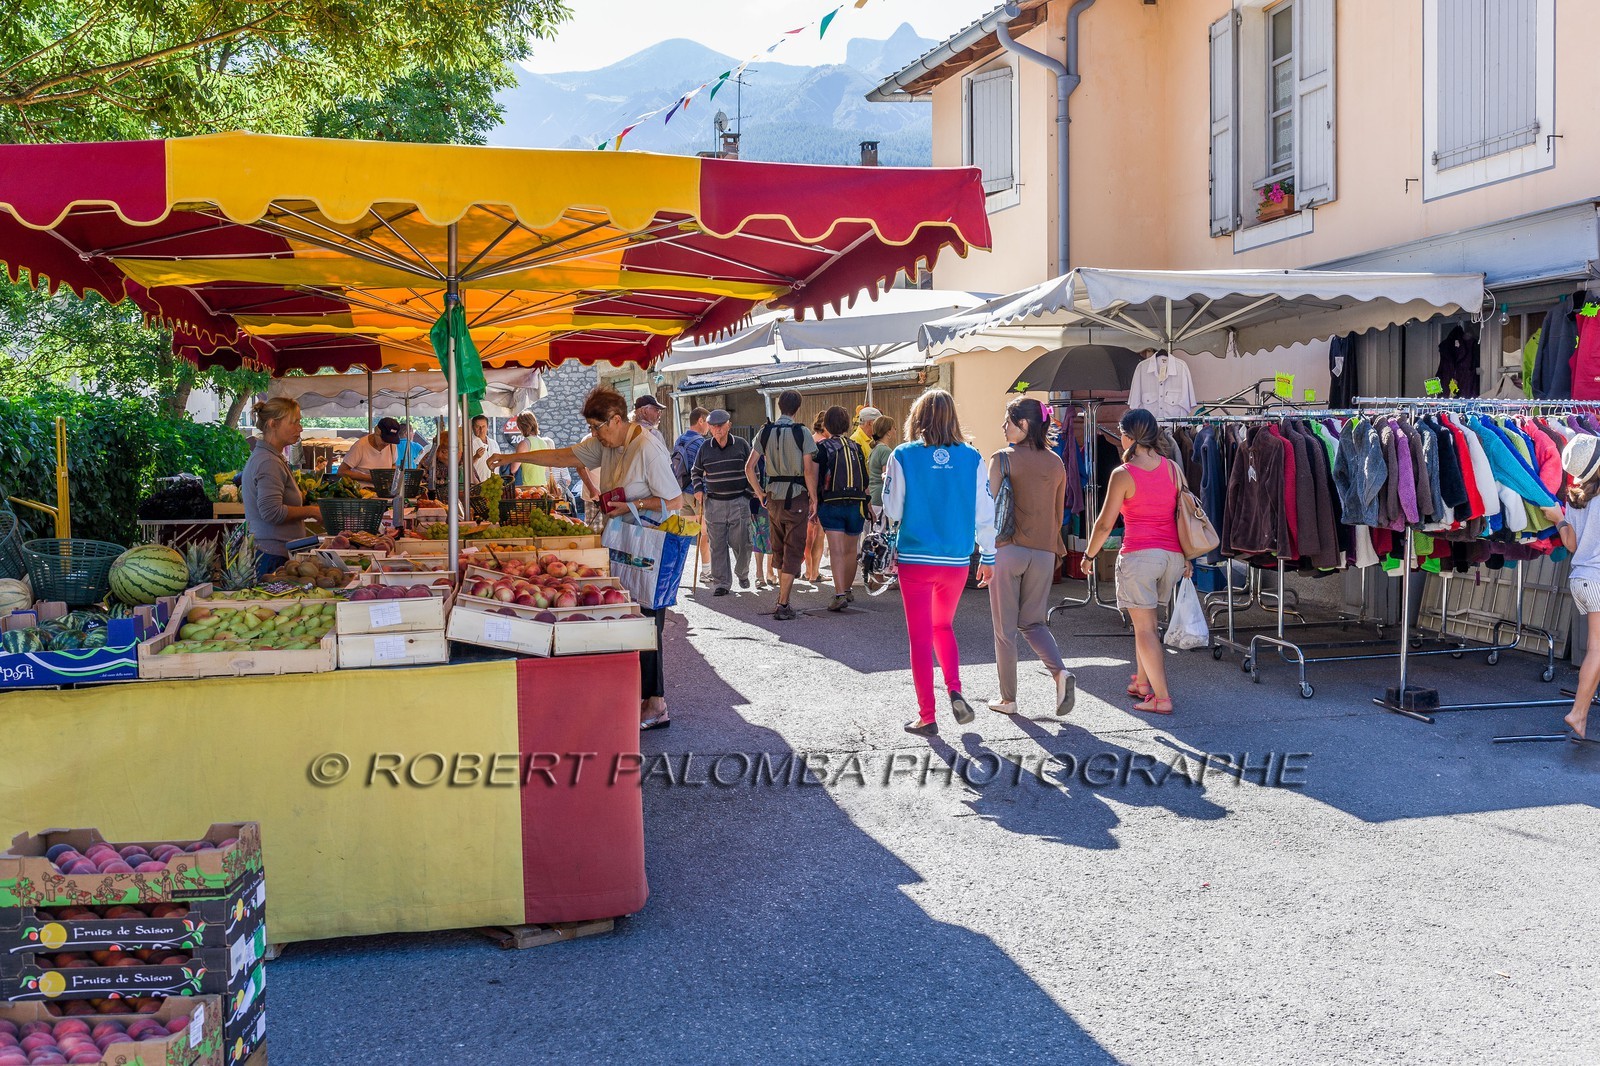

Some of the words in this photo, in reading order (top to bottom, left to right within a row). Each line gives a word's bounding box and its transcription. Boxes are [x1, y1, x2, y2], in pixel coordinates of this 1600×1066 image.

[73, 927, 113, 939] Fruits
[117, 926, 131, 935] de
[135, 925, 174, 935] Saison
[72, 975, 112, 987] Fruits
[116, 974, 129, 983] de
[134, 973, 173, 983] Saison
